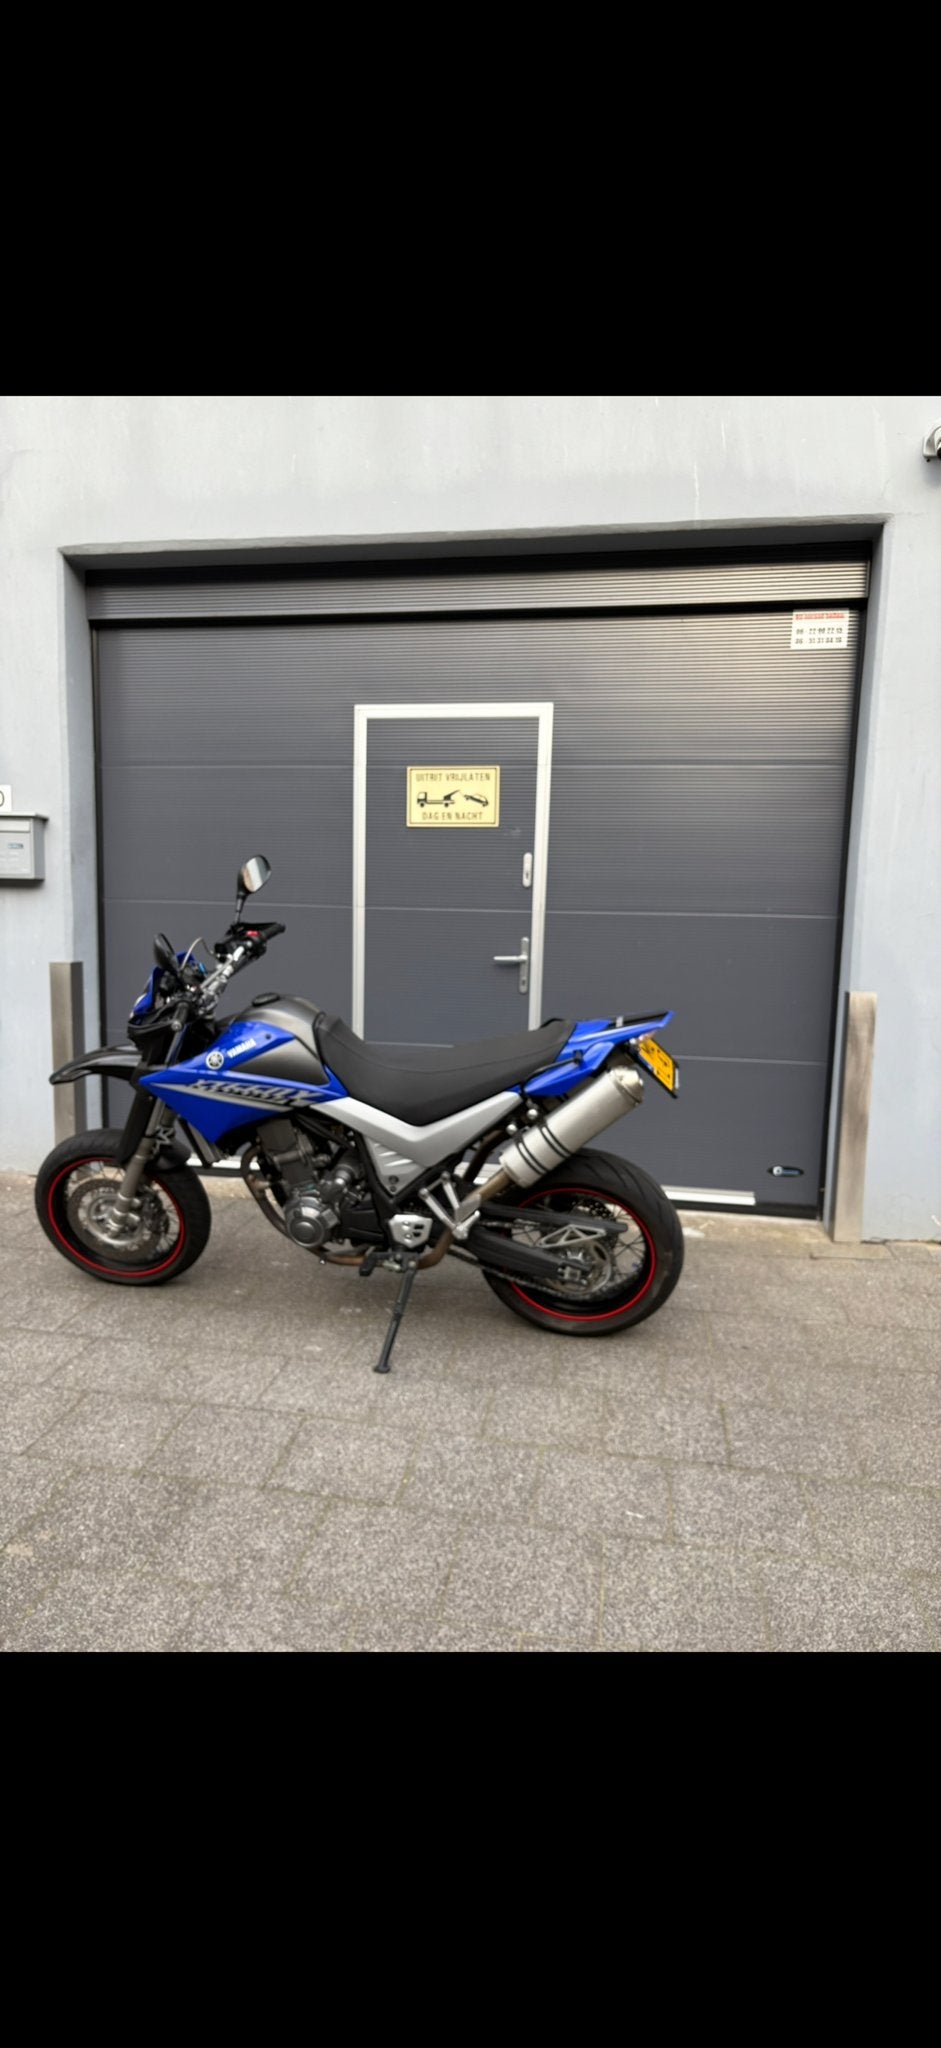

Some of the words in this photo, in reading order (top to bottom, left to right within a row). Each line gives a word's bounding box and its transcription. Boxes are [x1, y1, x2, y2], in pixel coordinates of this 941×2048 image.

[415, 773, 443, 782] UITRIT
[445, 772, 491, 782] VRIJLATEN
[421, 812, 439, 821] DAG
[441, 812, 453, 820] EN
[455, 811, 483, 820] NACHT
[226, 1038, 257, 1059] YAMAHA
